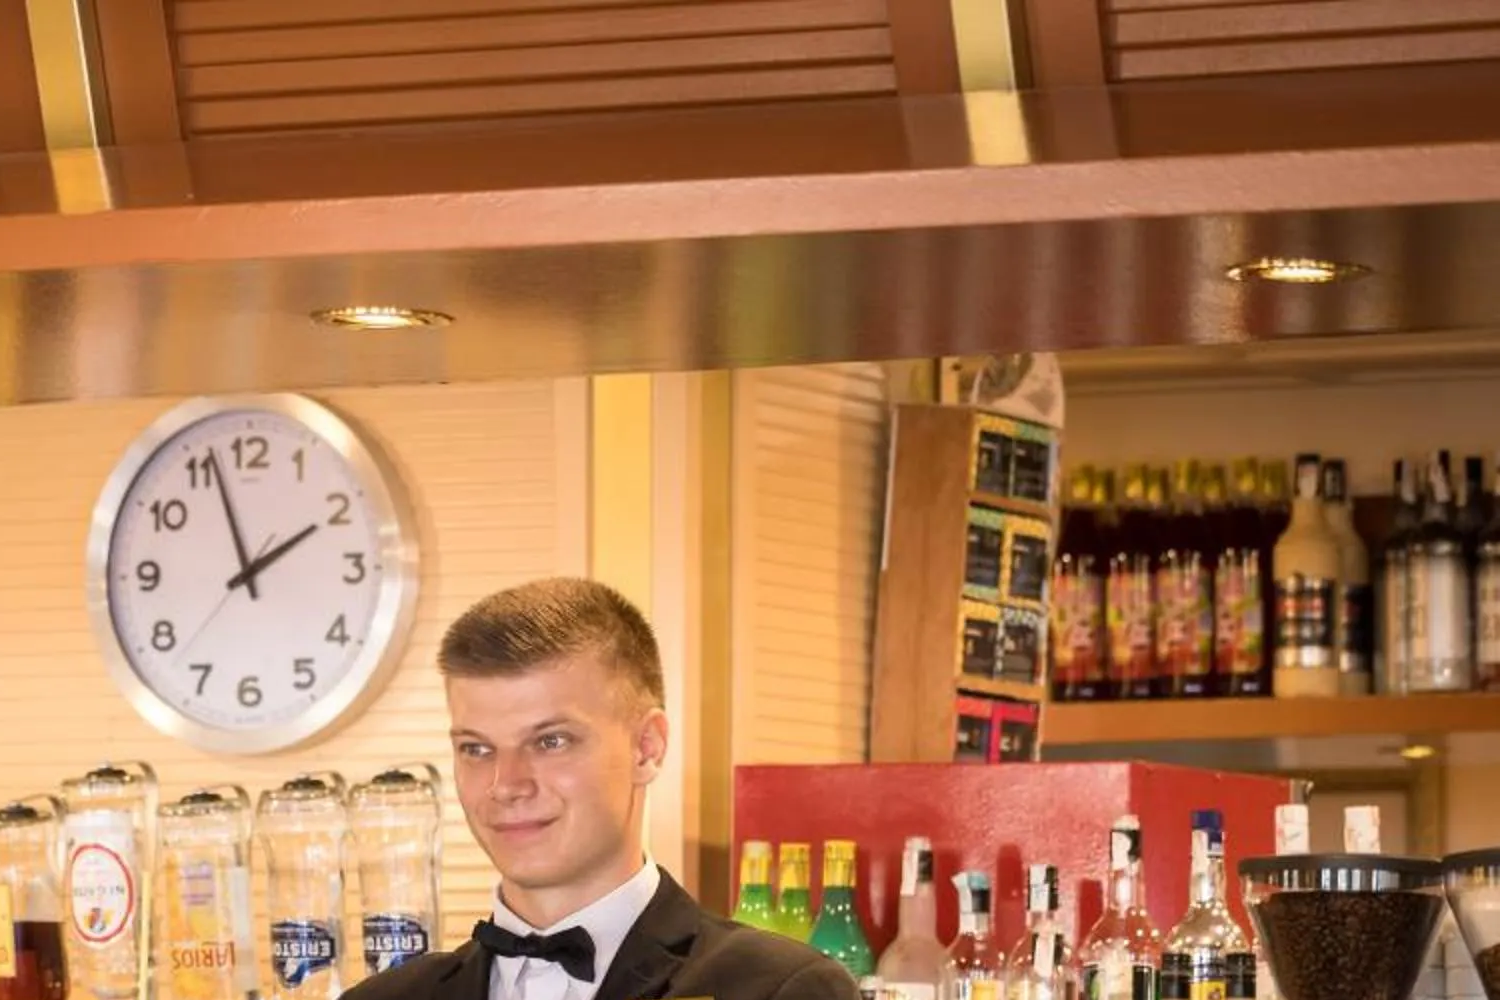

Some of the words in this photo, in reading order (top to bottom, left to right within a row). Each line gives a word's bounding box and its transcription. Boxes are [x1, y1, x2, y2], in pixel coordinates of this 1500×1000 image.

[231, 436, 271, 470] 12
[292, 448, 305, 483] 1
[185, 455, 212, 489] 11
[149, 499, 188, 532] 10
[325, 493, 352, 525] 2
[136, 560, 162, 592] 9
[342, 552, 366, 585] 3
[151, 620, 177, 652] 8
[324, 613, 351, 647] 4
[188, 664, 213, 695] 7
[292, 658, 317, 690] 5
[237, 675, 263, 708] 6
[171, 940, 236, 969] LARIOS
